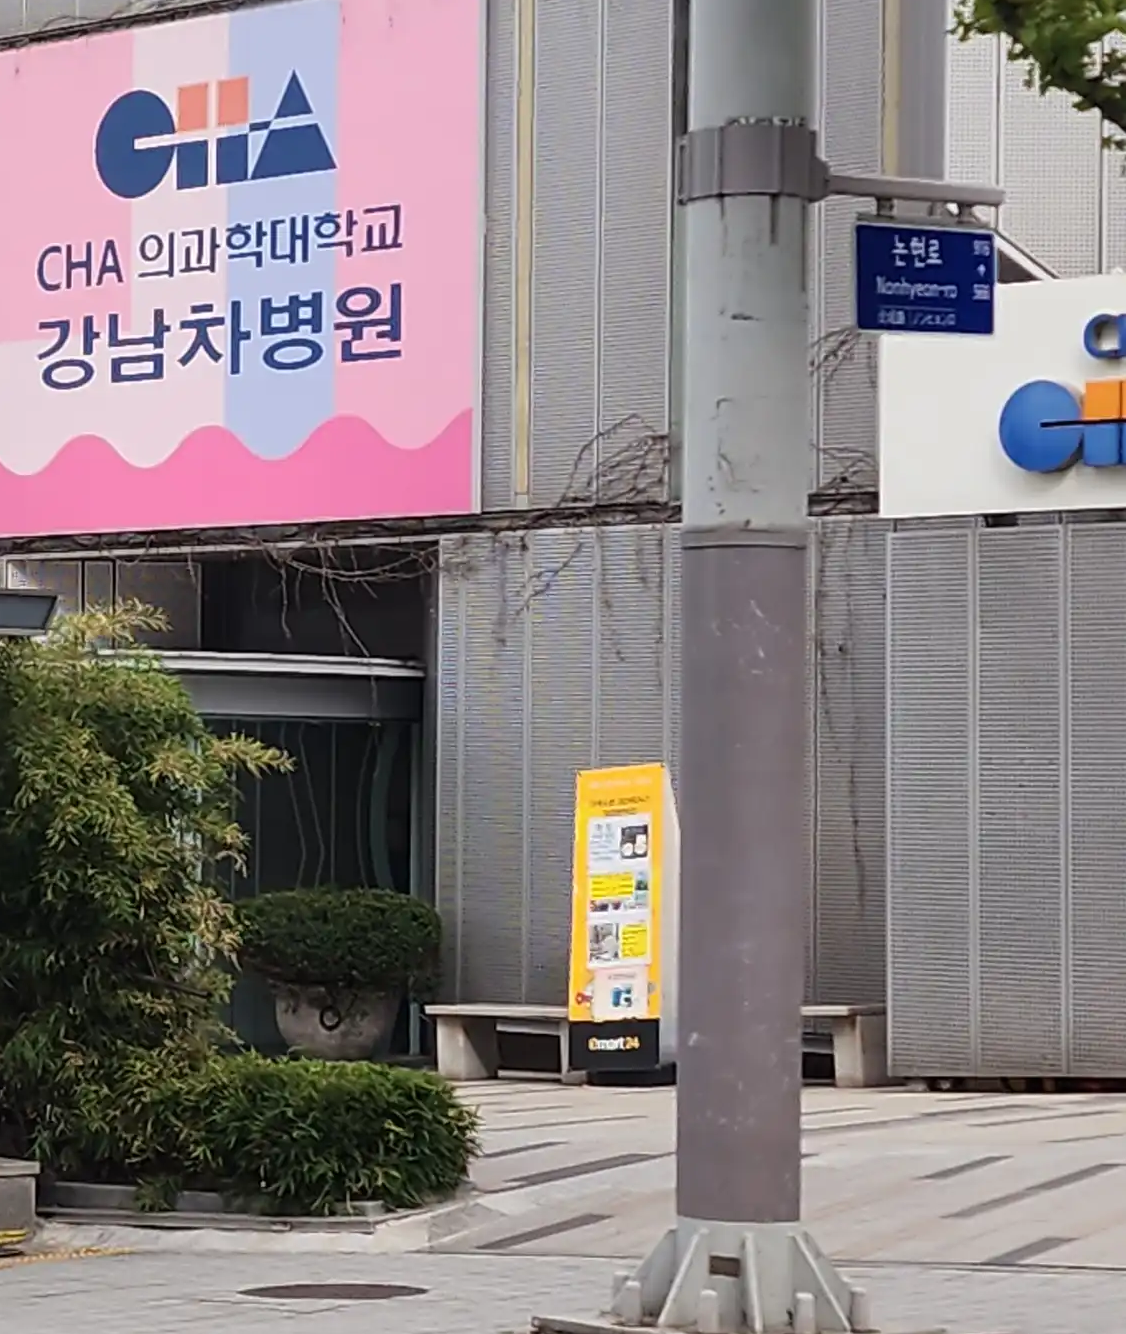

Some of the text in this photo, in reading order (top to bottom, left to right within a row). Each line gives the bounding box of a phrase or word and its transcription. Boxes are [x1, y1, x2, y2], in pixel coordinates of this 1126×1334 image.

[36, 204, 404, 292] CHA 의과학대학교
[891, 234, 943, 268] 논현로
[35, 282, 403, 391] 강남차병원
